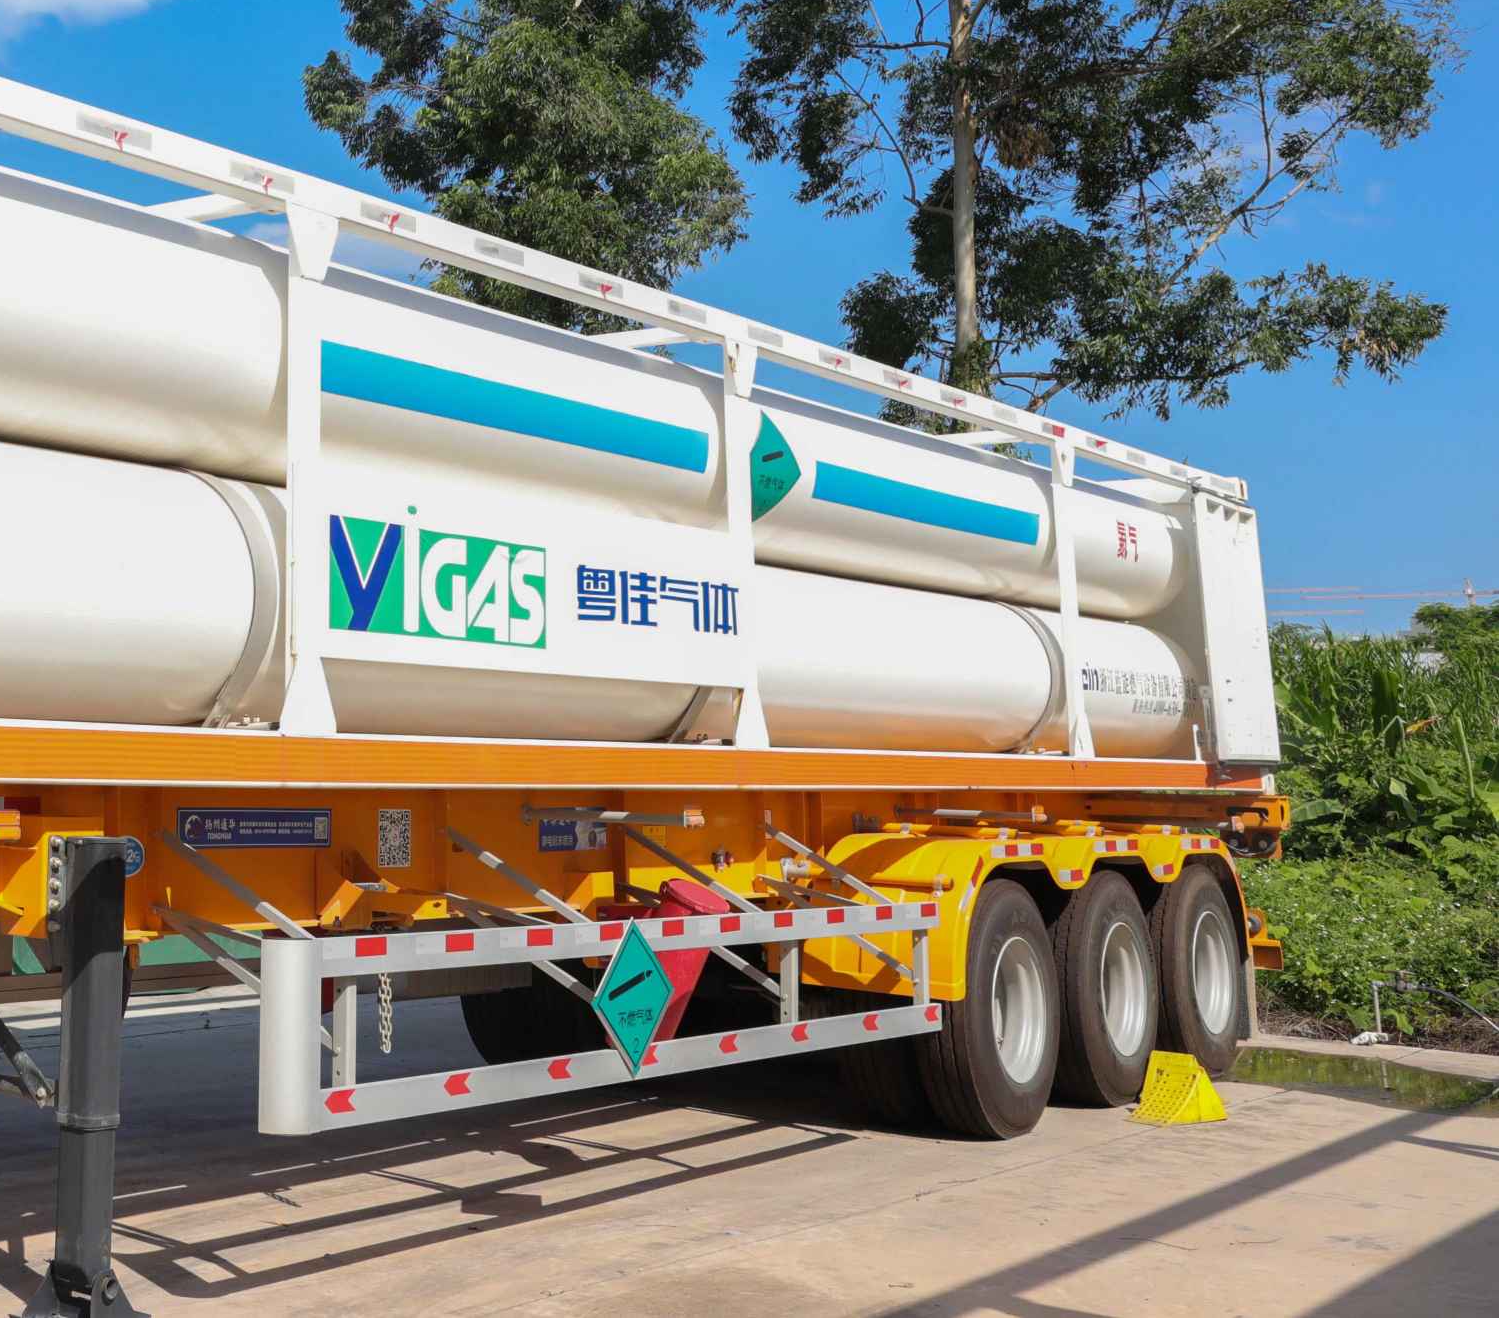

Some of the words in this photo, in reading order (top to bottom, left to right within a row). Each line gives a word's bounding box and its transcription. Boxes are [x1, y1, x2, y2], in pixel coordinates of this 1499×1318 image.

[576, 564, 739, 636] 粤佳气体
[618, 1008, 653, 1027] 不燃气体
